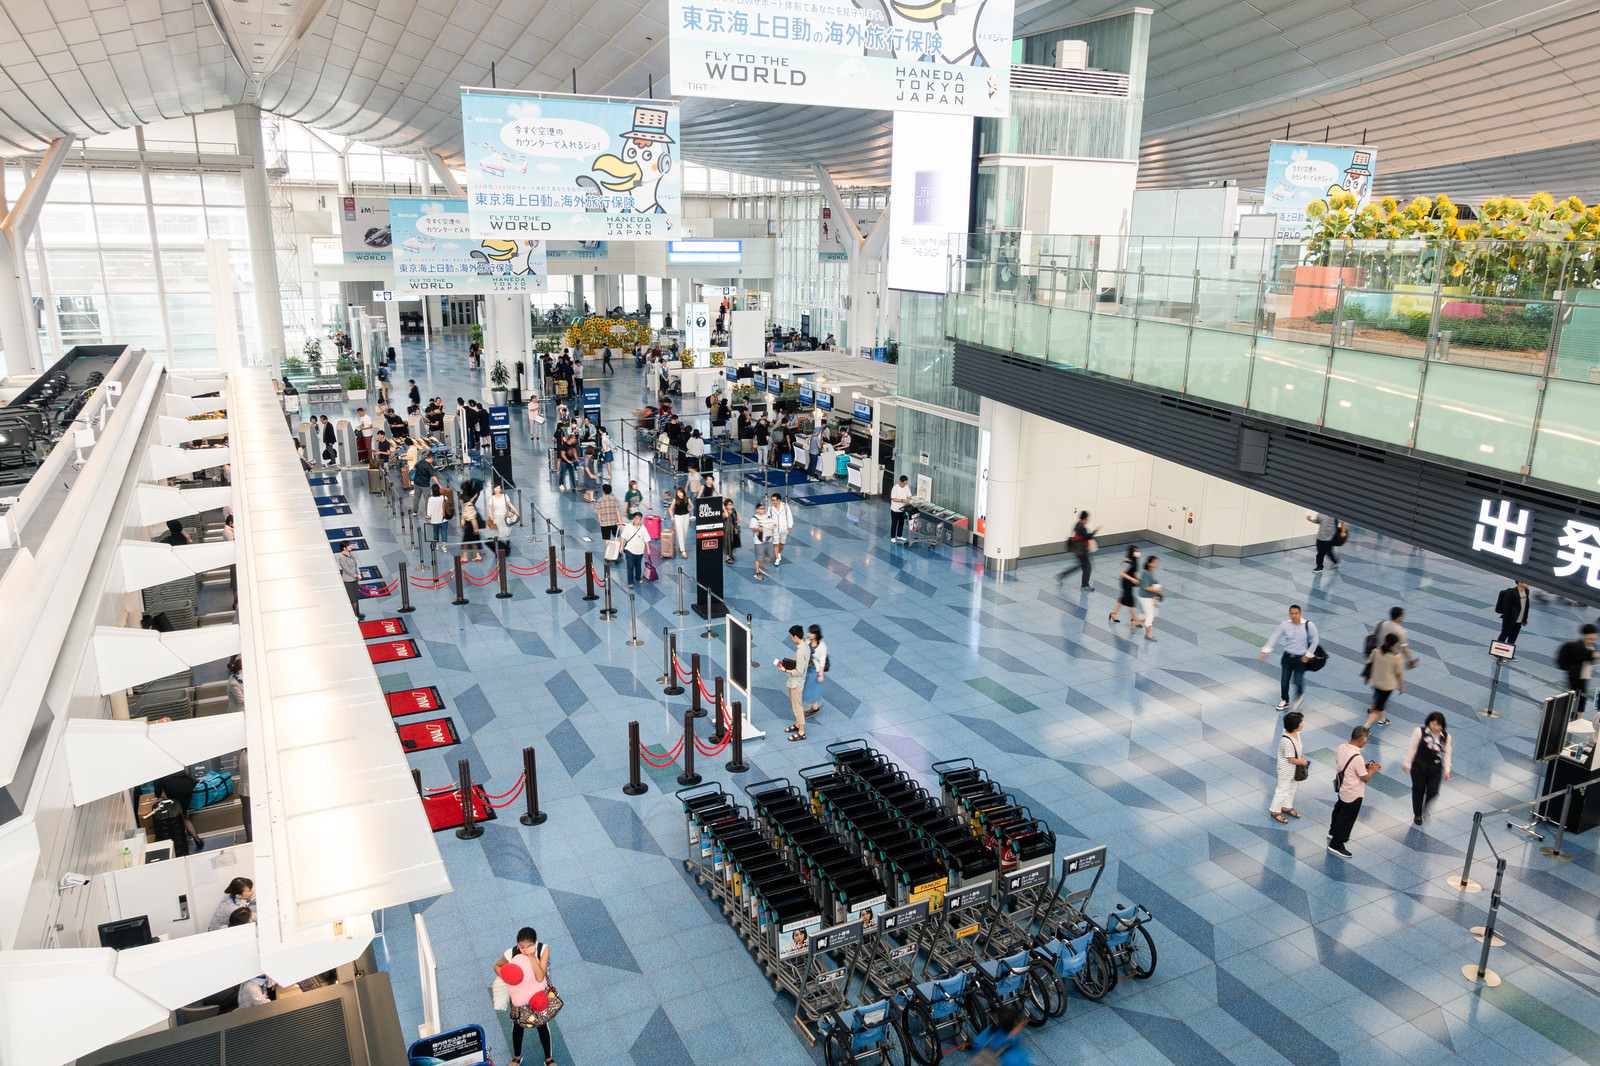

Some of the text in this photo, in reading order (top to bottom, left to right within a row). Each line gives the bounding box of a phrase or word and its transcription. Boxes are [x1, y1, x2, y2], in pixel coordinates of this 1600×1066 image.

[681, 5, 943, 54] 東京海上日動の海外旅行保険
[705, 50, 790, 67] FLY TO THE
[705, 62, 807, 86] WORLD
[896, 67, 964, 82] HANEDA
[896, 79, 965, 94] TOKYO
[896, 92, 964, 105] JAPAN
[514, 125, 563, 136] 今すぐ空港の
[474, 192, 635, 209] 東京海上日動の海外旅行保険
[490, 221, 551, 231] WORLD
[920, 880, 942, 890] FANUC
